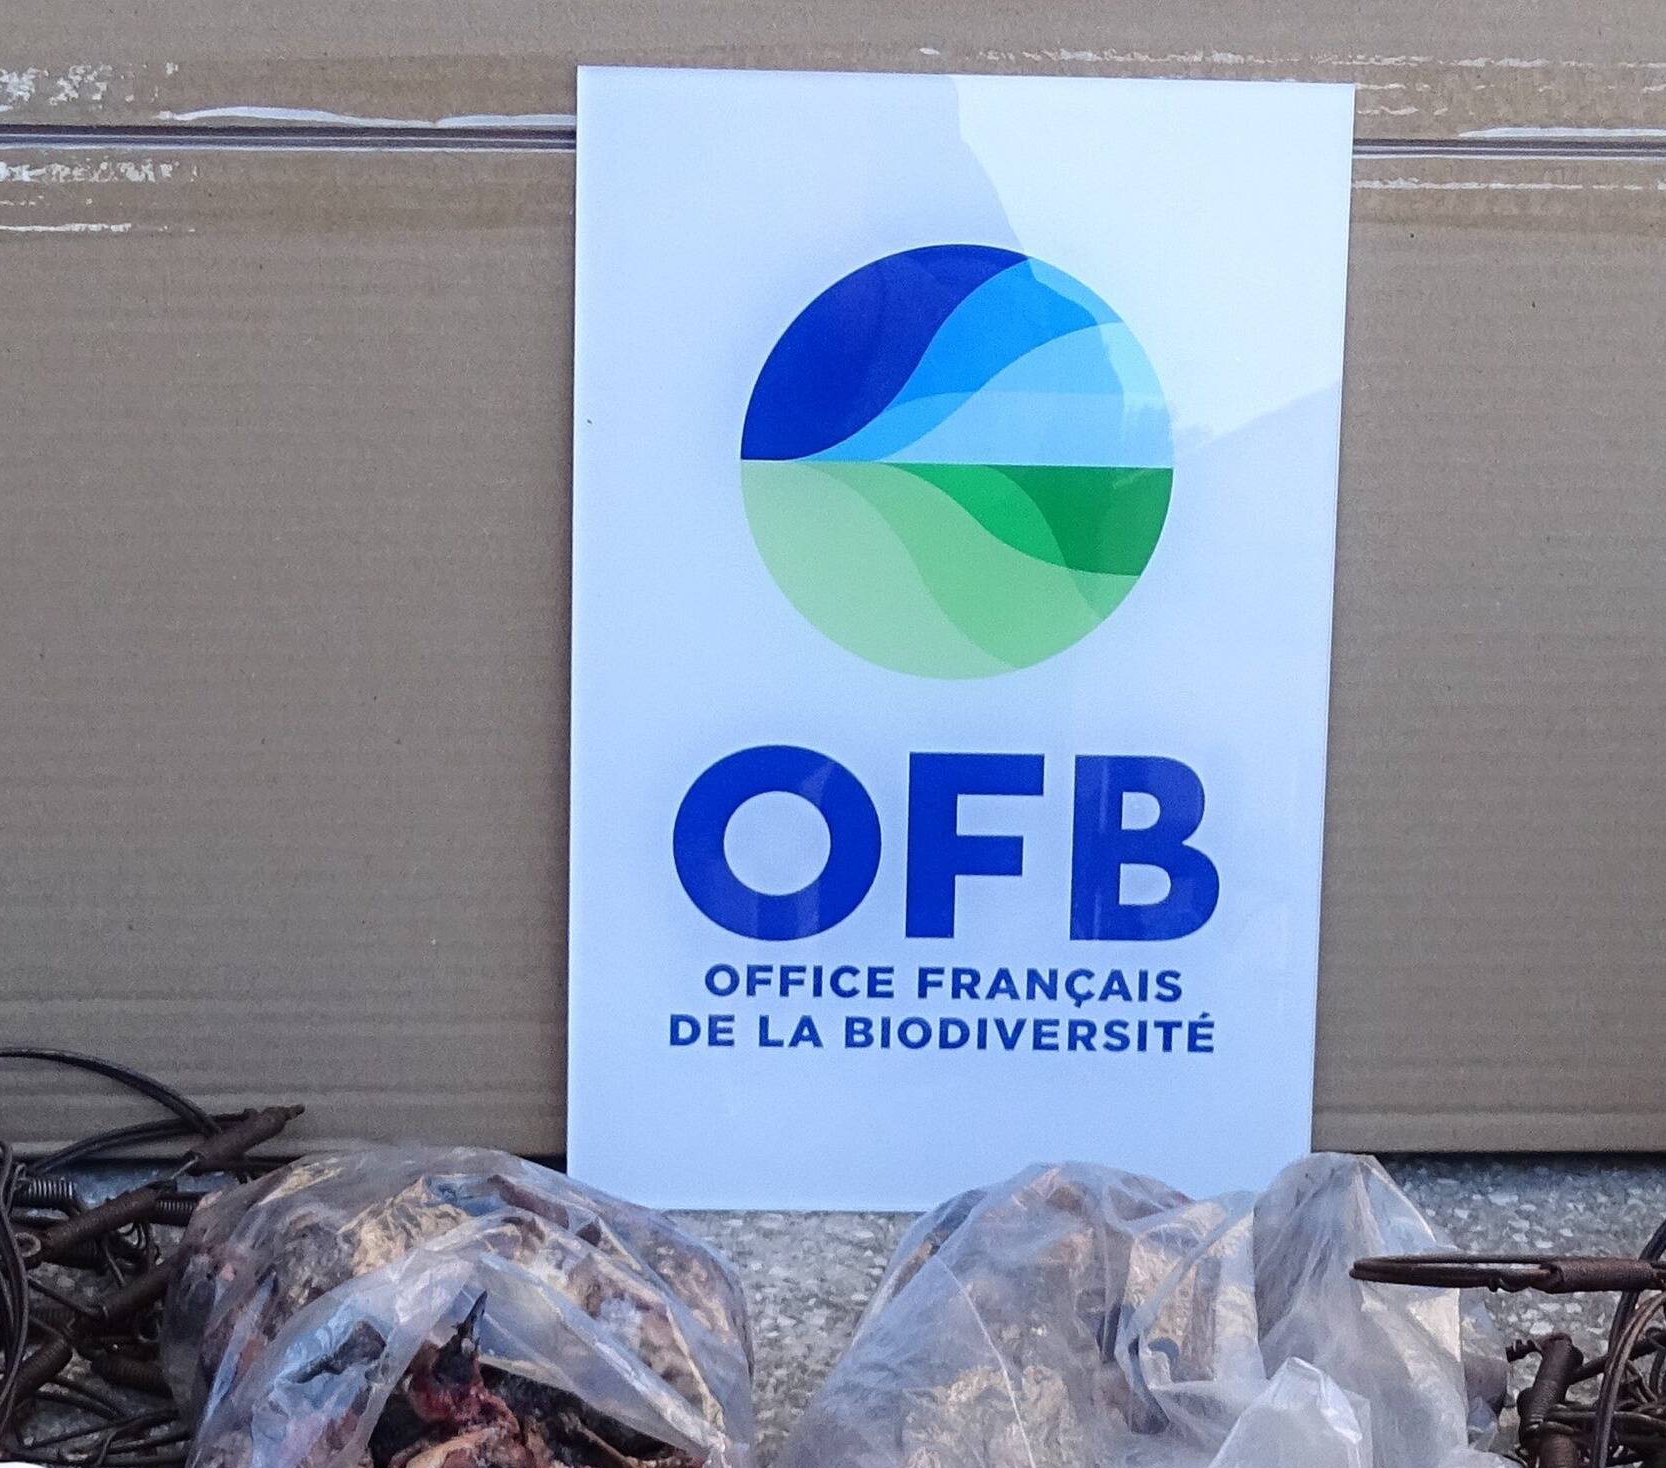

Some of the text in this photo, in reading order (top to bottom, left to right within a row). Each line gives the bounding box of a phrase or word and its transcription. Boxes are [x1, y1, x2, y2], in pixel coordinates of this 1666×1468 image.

[673, 744, 1220, 941] OFB
[704, 963, 1183, 1008] OFFICE FRANÇAIS
[669, 1011, 1215, 1053] DE LA BIODIVERSITÉ
